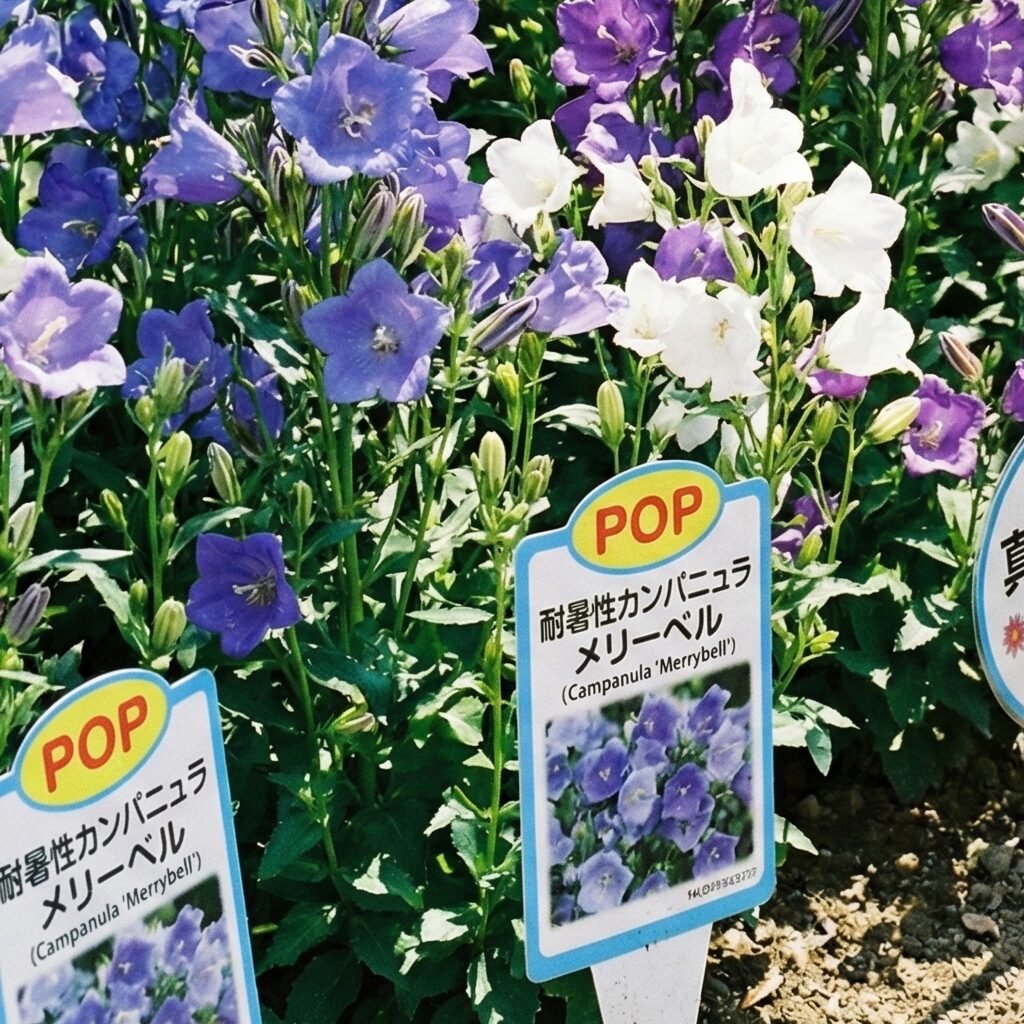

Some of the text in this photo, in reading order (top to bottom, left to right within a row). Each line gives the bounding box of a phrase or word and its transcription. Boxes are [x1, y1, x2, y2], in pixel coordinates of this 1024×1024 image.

[596, 485, 703, 556] POP
[539, 555, 752, 643] 耐暑性カンパニュラ
[575, 604, 723, 675] メリーベル
[561, 664, 652, 705] (Campanula
[42, 695, 148, 794] POP
[0, 757, 207, 905] 耐暑性カンパニュラ
[42, 820, 185, 931] メリーベル
[30, 851, 202, 967] (Campanula 'Merrybell')
